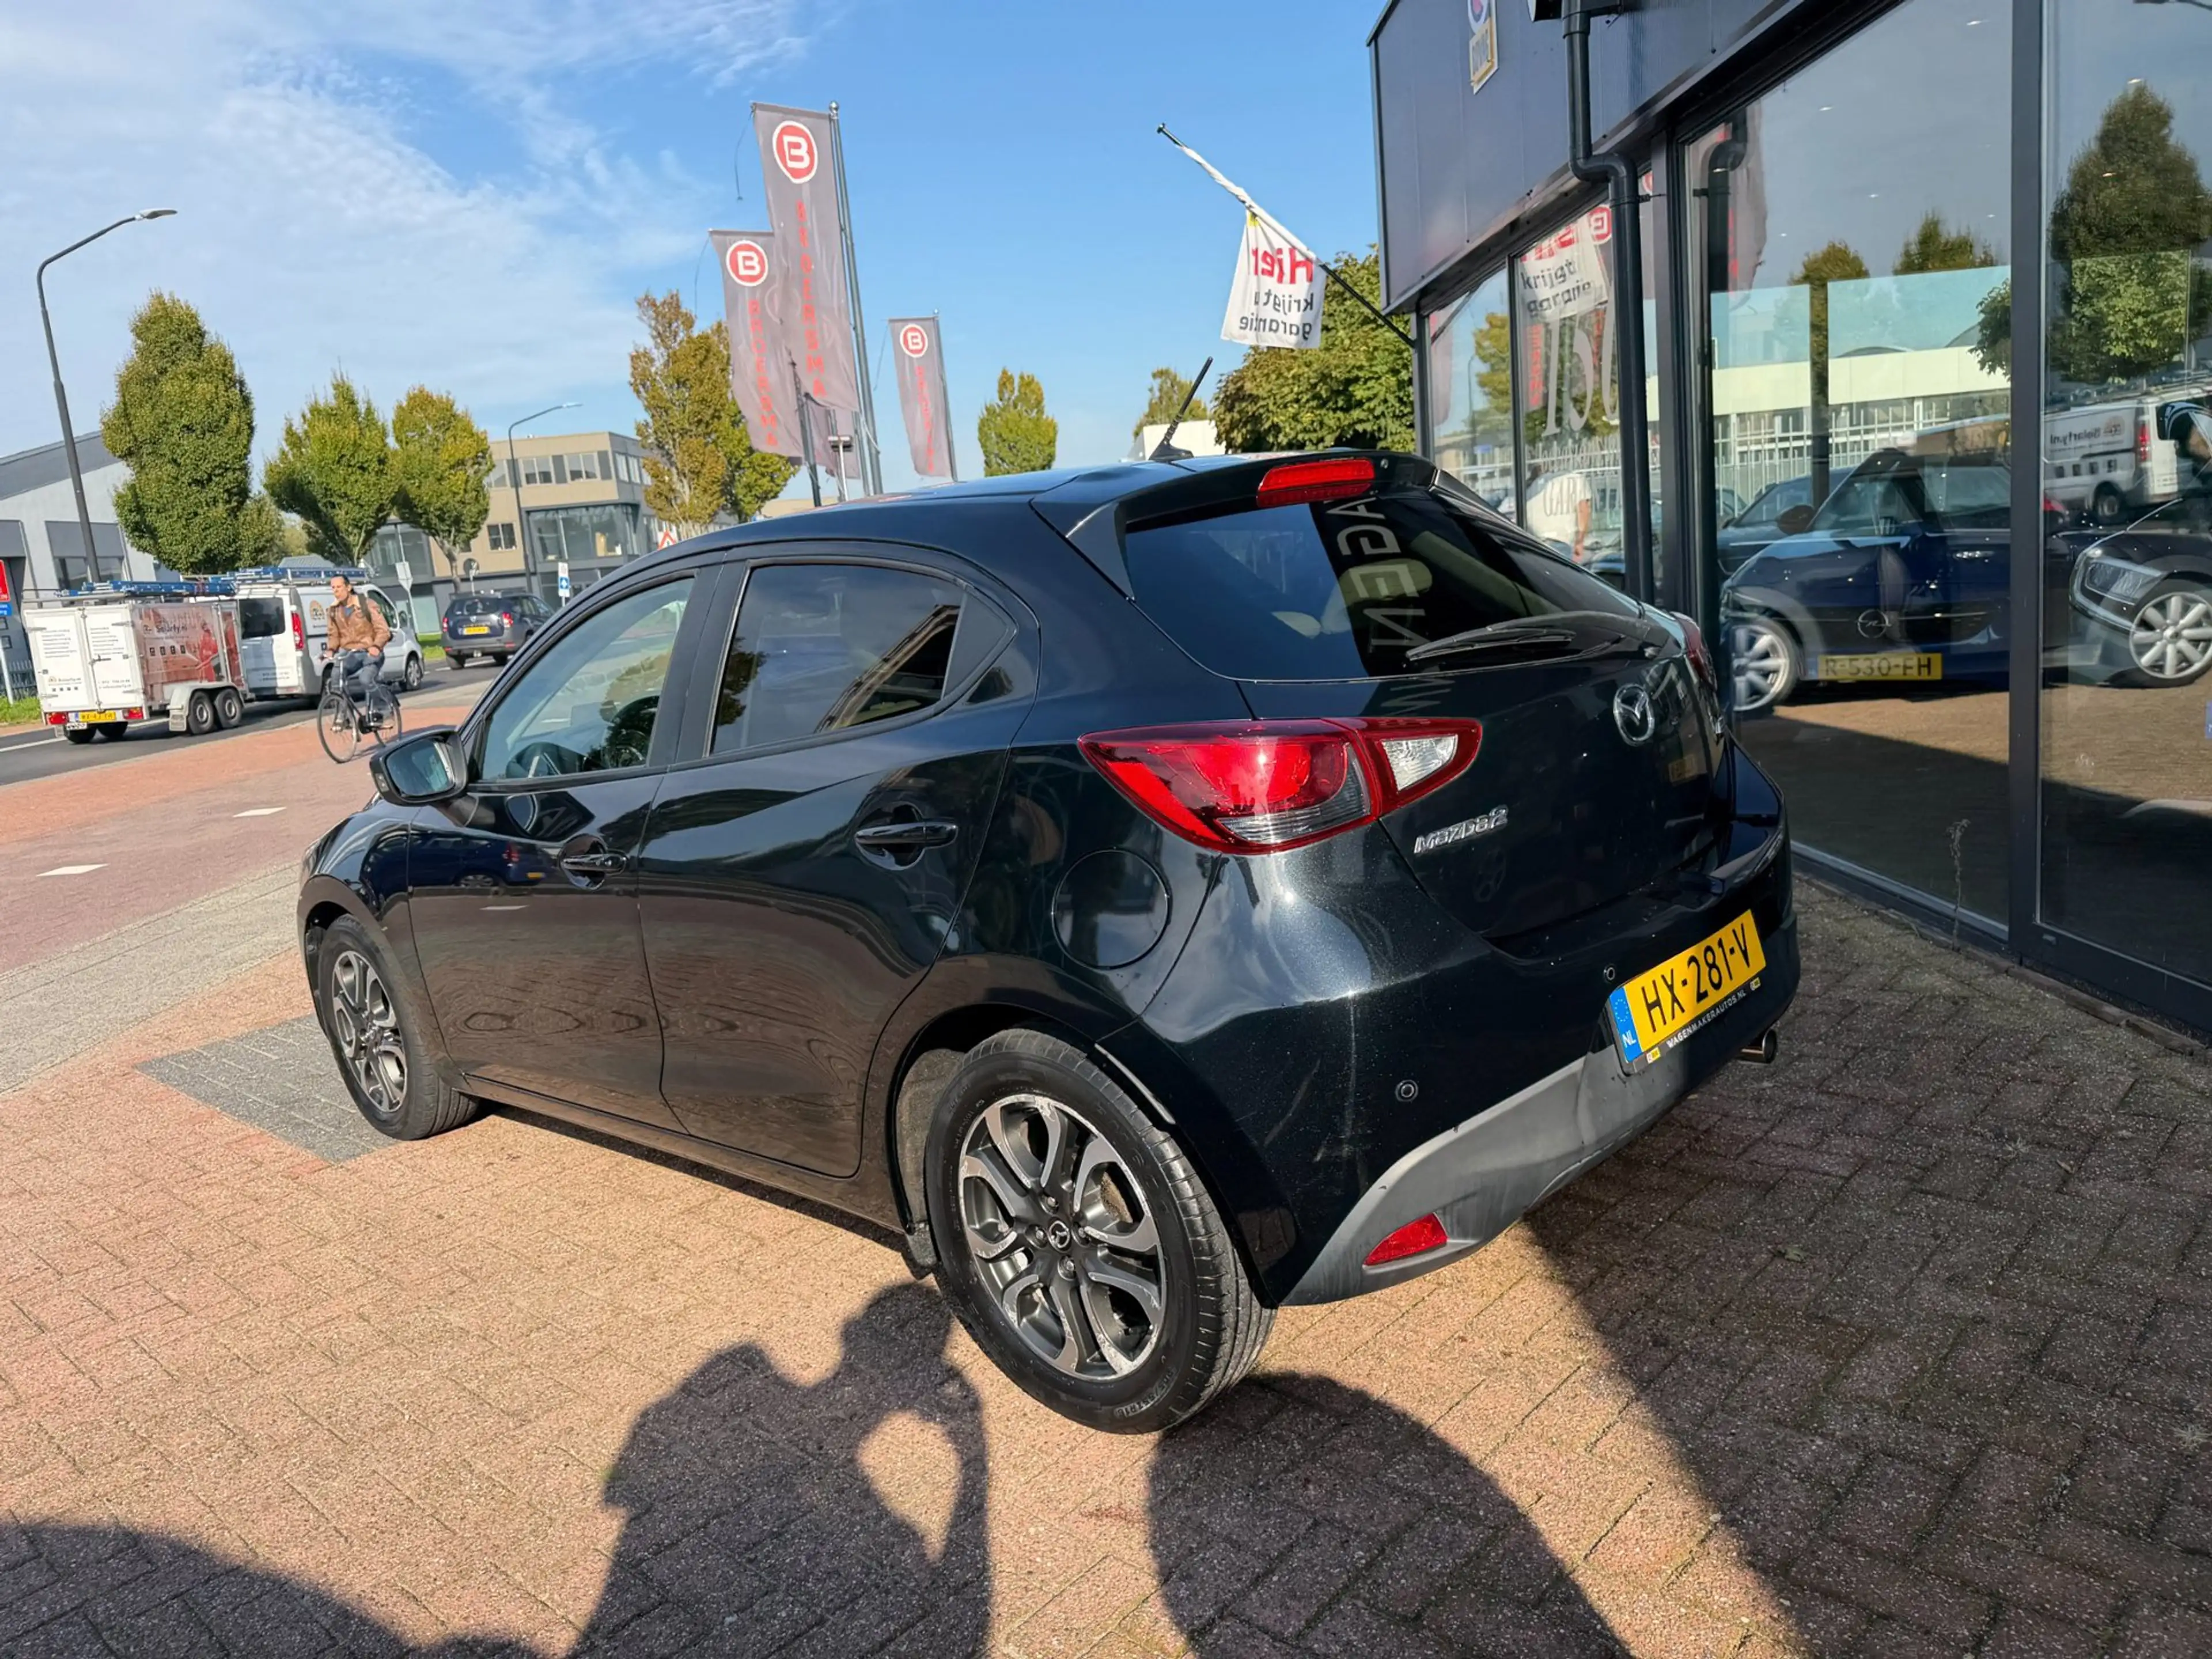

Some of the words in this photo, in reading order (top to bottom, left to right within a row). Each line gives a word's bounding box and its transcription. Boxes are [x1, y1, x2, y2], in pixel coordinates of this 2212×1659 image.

[783, 135, 810, 169] B
[737, 251, 761, 276] B
[907, 331, 922, 350] B
[748, 299, 778, 447] BROERSMA
[1642, 923, 1751, 1033] HX-281-V
[1623, 1030, 1637, 1048] NL
